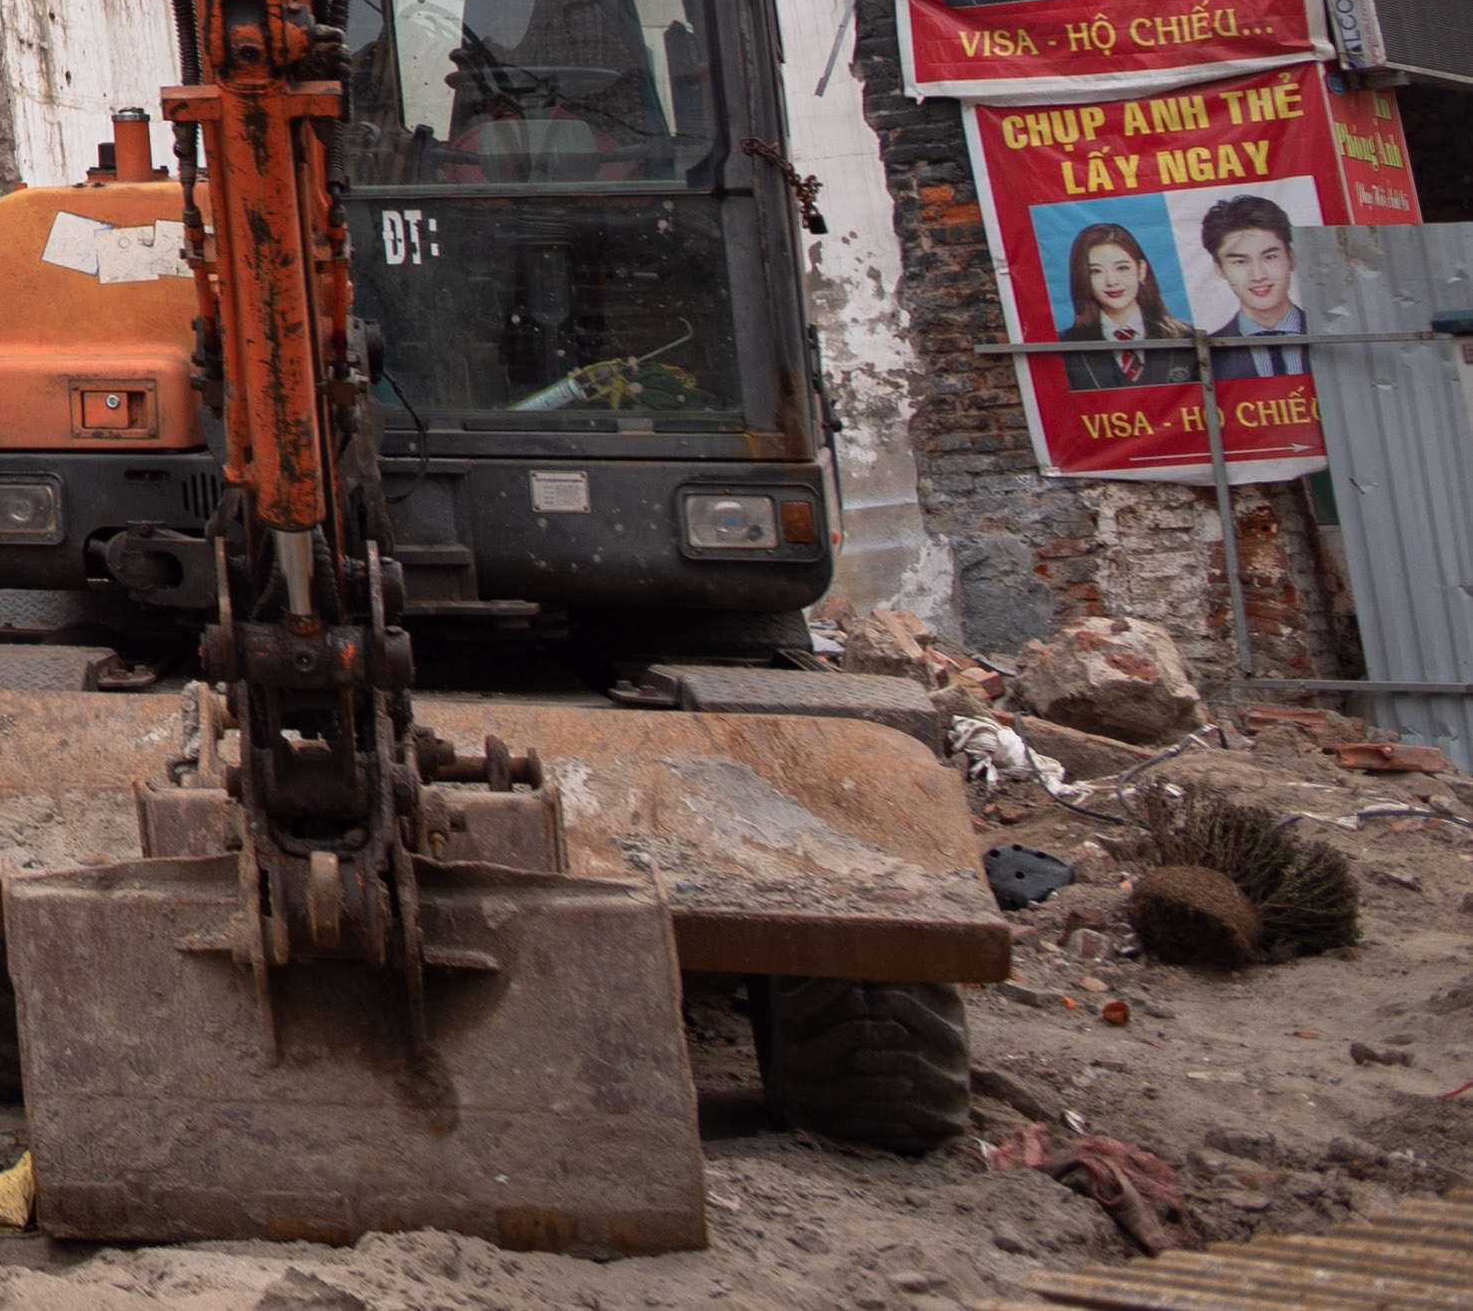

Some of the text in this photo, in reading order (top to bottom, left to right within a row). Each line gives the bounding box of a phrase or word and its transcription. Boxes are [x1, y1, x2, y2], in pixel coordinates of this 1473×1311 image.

[959, 29, 1037, 58] VISA
[1067, 14, 1117, 56] HỘ
[1002, 106, 1105, 153] CHỤP
[1220, 72, 1303, 126] THẺ
[1061, 140, 1270, 195] LẤY NGAY
[1081, 411, 1154, 439] VISA
